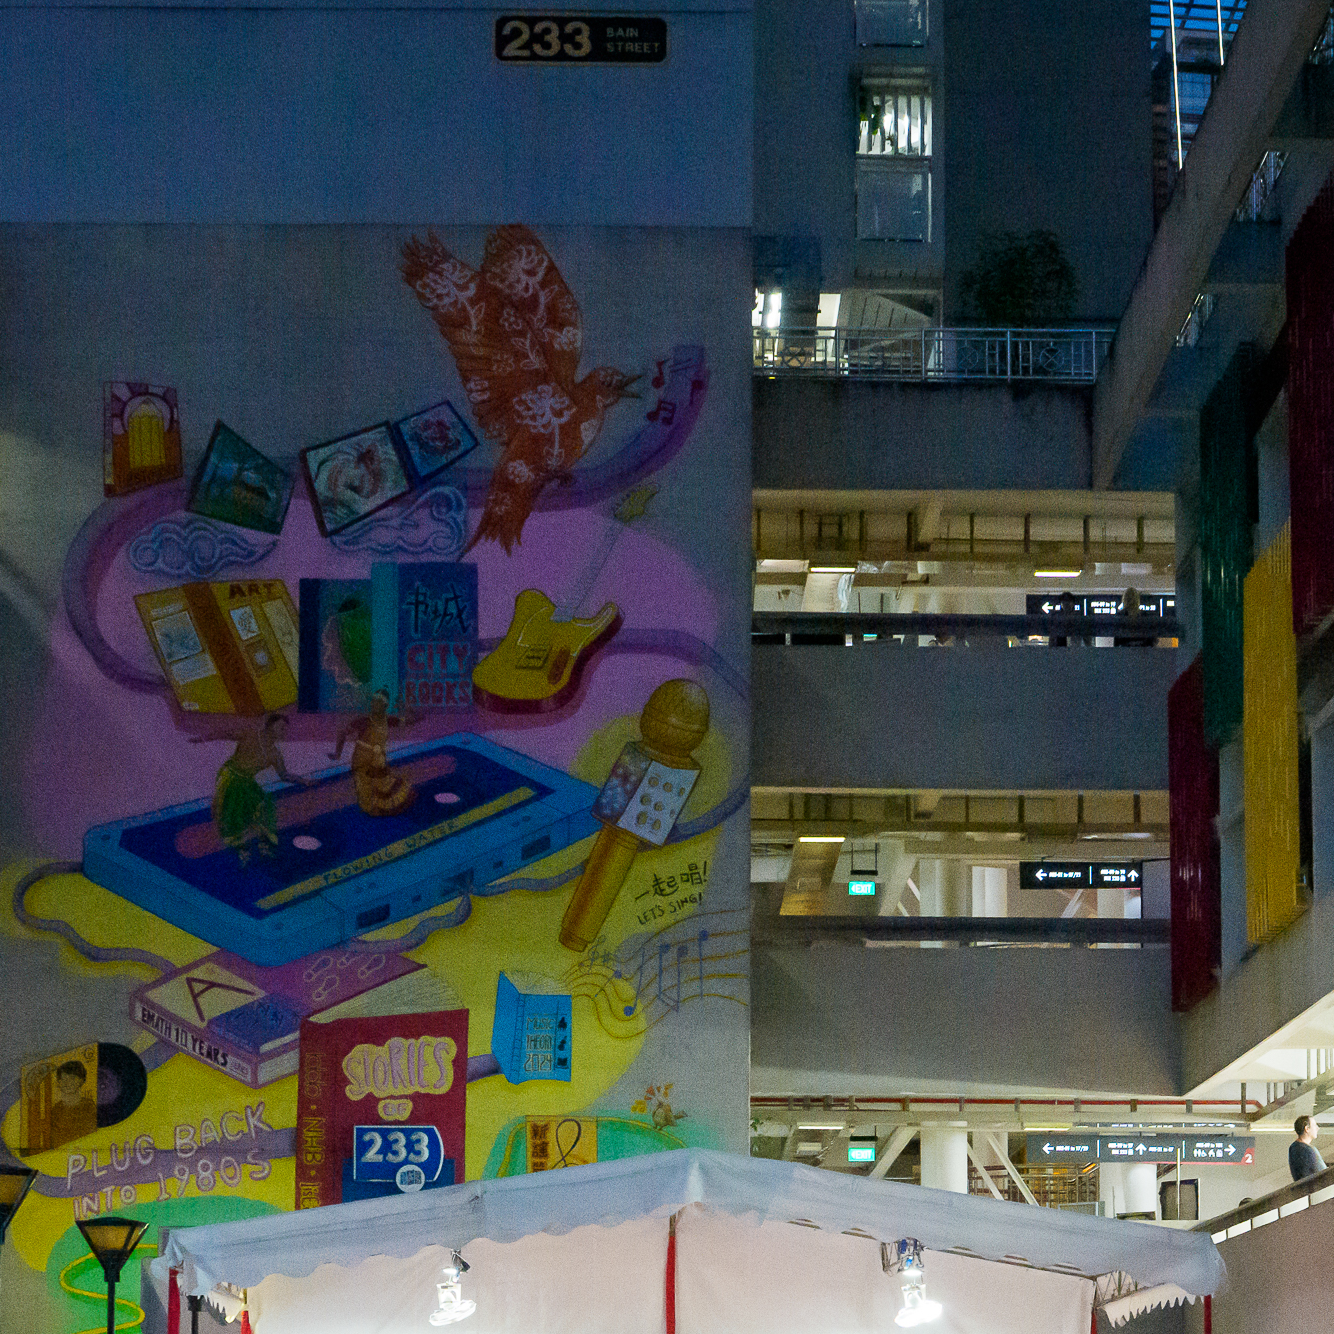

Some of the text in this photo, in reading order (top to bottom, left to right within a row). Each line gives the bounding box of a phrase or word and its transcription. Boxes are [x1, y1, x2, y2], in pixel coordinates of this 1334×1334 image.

[502, 20, 592, 58] 233
[606, 27, 639, 38] BAIN
[606, 42, 661, 53] STREET
[229, 582, 275, 599] ART
[406, 642, 470, 671] CITY
[405, 681, 471, 705] BOOKS
[324, 849, 394, 885] FLOWING
[855, 884, 872, 893] EXIT
[668, 892, 703, 914] SING!
[191, 1036, 228, 1067] YEARS
[344, 1039, 451, 1097] STORIES
[381, 1102, 409, 1117] OF
[67, 1100, 273, 1190] PLUG BACK
[303, 1117, 326, 1165] NHB
[360, 1130, 430, 1164] 233
[855, 1150, 872, 1159] EXIT
[1245, 1153, 1253, 1164] 2
[74, 1182, 137, 1219] INTO
[156, 1148, 272, 1202] 1980S
